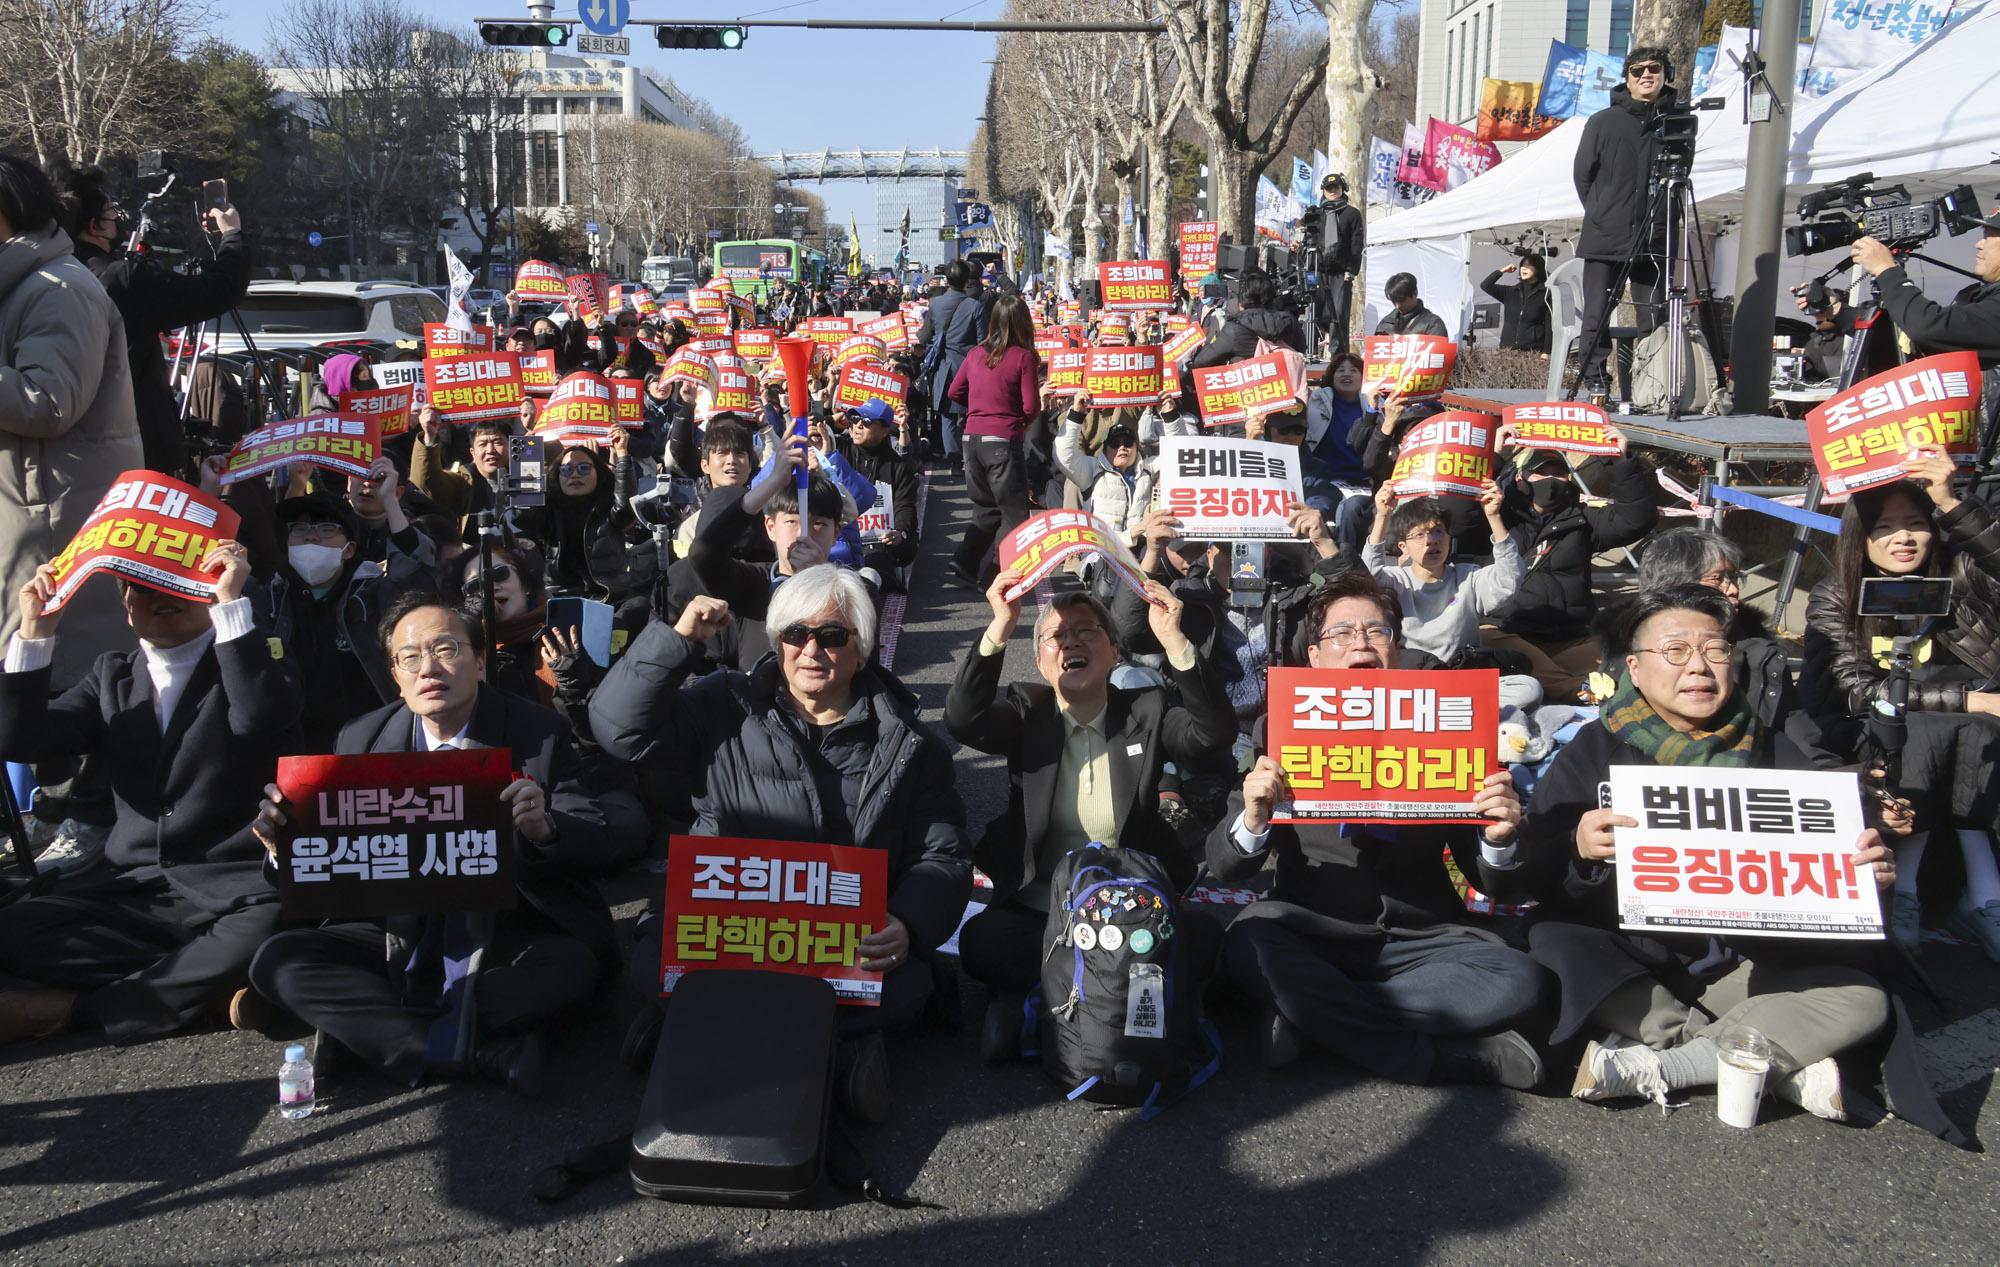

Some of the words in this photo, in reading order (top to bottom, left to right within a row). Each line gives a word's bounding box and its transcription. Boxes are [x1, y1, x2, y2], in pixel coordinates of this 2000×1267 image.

[580, 38, 627, 53] 좌회전시
[771, 254, 785, 267] 13
[1107, 266, 1164, 281] 조희대를
[1105, 286, 1169, 300] 탄핵하라!
[739, 334, 770, 343] 조희대를
[812, 321, 849, 331] 조희대를
[862, 319, 898, 334] 조희대를
[737, 346, 772, 355] 탄핵하라!
[1091, 353, 1155, 372] 조희대를
[435, 360, 511, 385] 조희대를
[522, 371, 552, 384] 하라!
[848, 368, 902, 394] 조희대를
[1087, 374, 1160, 394] 탄핵하라!
[1204, 362, 1278, 390] 조희대를
[350, 393, 408, 414] 조희대를
[432, 383, 520, 411] 탄핵하라!
[1204, 379, 1288, 413] 탄핵하라!
[1824, 369, 1970, 433] 조희대를
[1515, 407, 1604, 424] 조희대를
[241, 417, 365, 450] 조희대를
[1403, 421, 1487, 454] 조희대를
[1822, 410, 1976, 471] 탄핵하라!
[229, 436, 373, 471] 탄핵하라!
[1178, 448, 1287, 480] 법비들을
[1392, 451, 1487, 481] 탄핵하라!
[856, 514, 890, 531] 하자!
[1293, 686, 1473, 732] 조희대를
[1281, 745, 1485, 791] 탄핵하라!
[318, 785, 464, 826] 내란수괴
[1315, 802, 1343, 810] 내란청산!
[1434, 803, 1456, 811] 모이자!
[1642, 786, 1836, 834] 법비들을
[291, 834, 410, 882] 윤석열
[419, 829, 498, 876] 사형
[691, 855, 861, 907] 조희대를
[1632, 846, 1860, 899] 응징하자!
[1673, 908, 1704, 917] 내란청산!
[1706, 909, 1752, 919] 국민주권실현!
[1754, 912, 1803, 920] 촛불대행진으로
[1807, 914, 1831, 922] 모이자!
